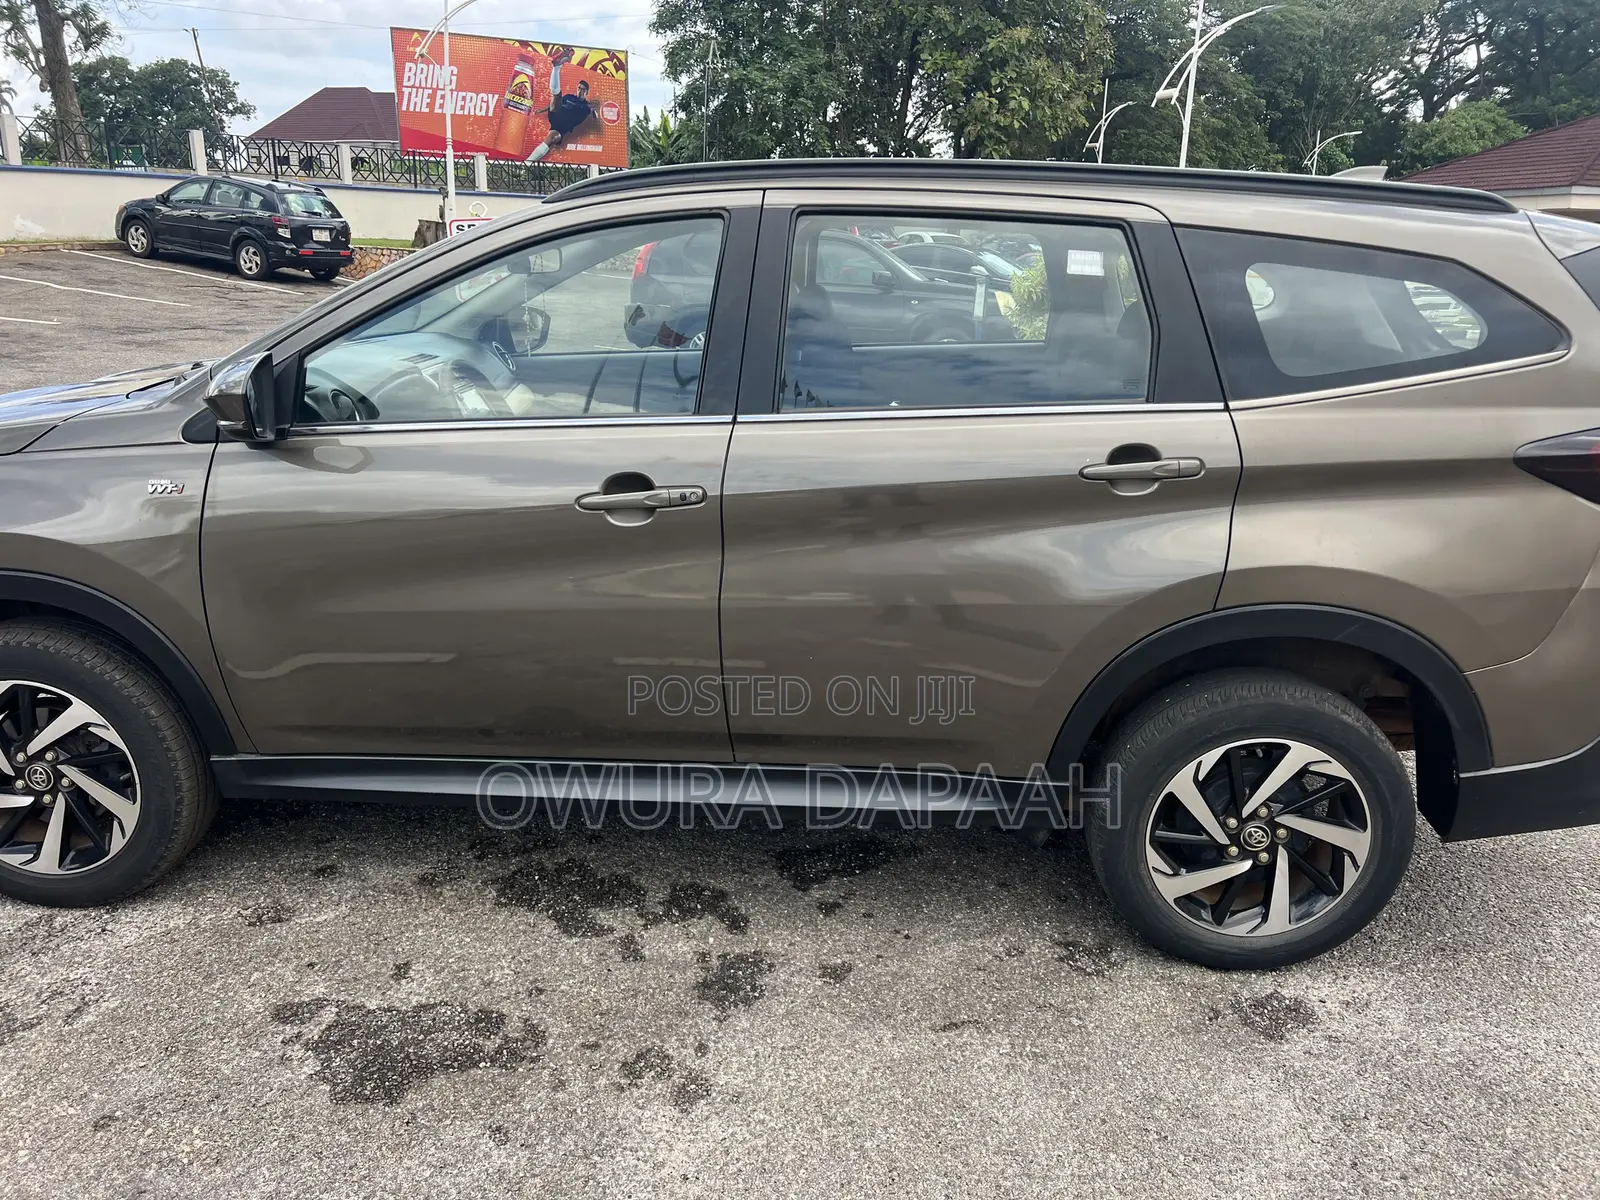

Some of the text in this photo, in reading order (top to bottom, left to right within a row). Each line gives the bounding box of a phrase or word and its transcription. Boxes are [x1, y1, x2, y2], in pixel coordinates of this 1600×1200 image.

[403, 62, 458, 90] BRING
[401, 87, 499, 117] THE ENERGY
